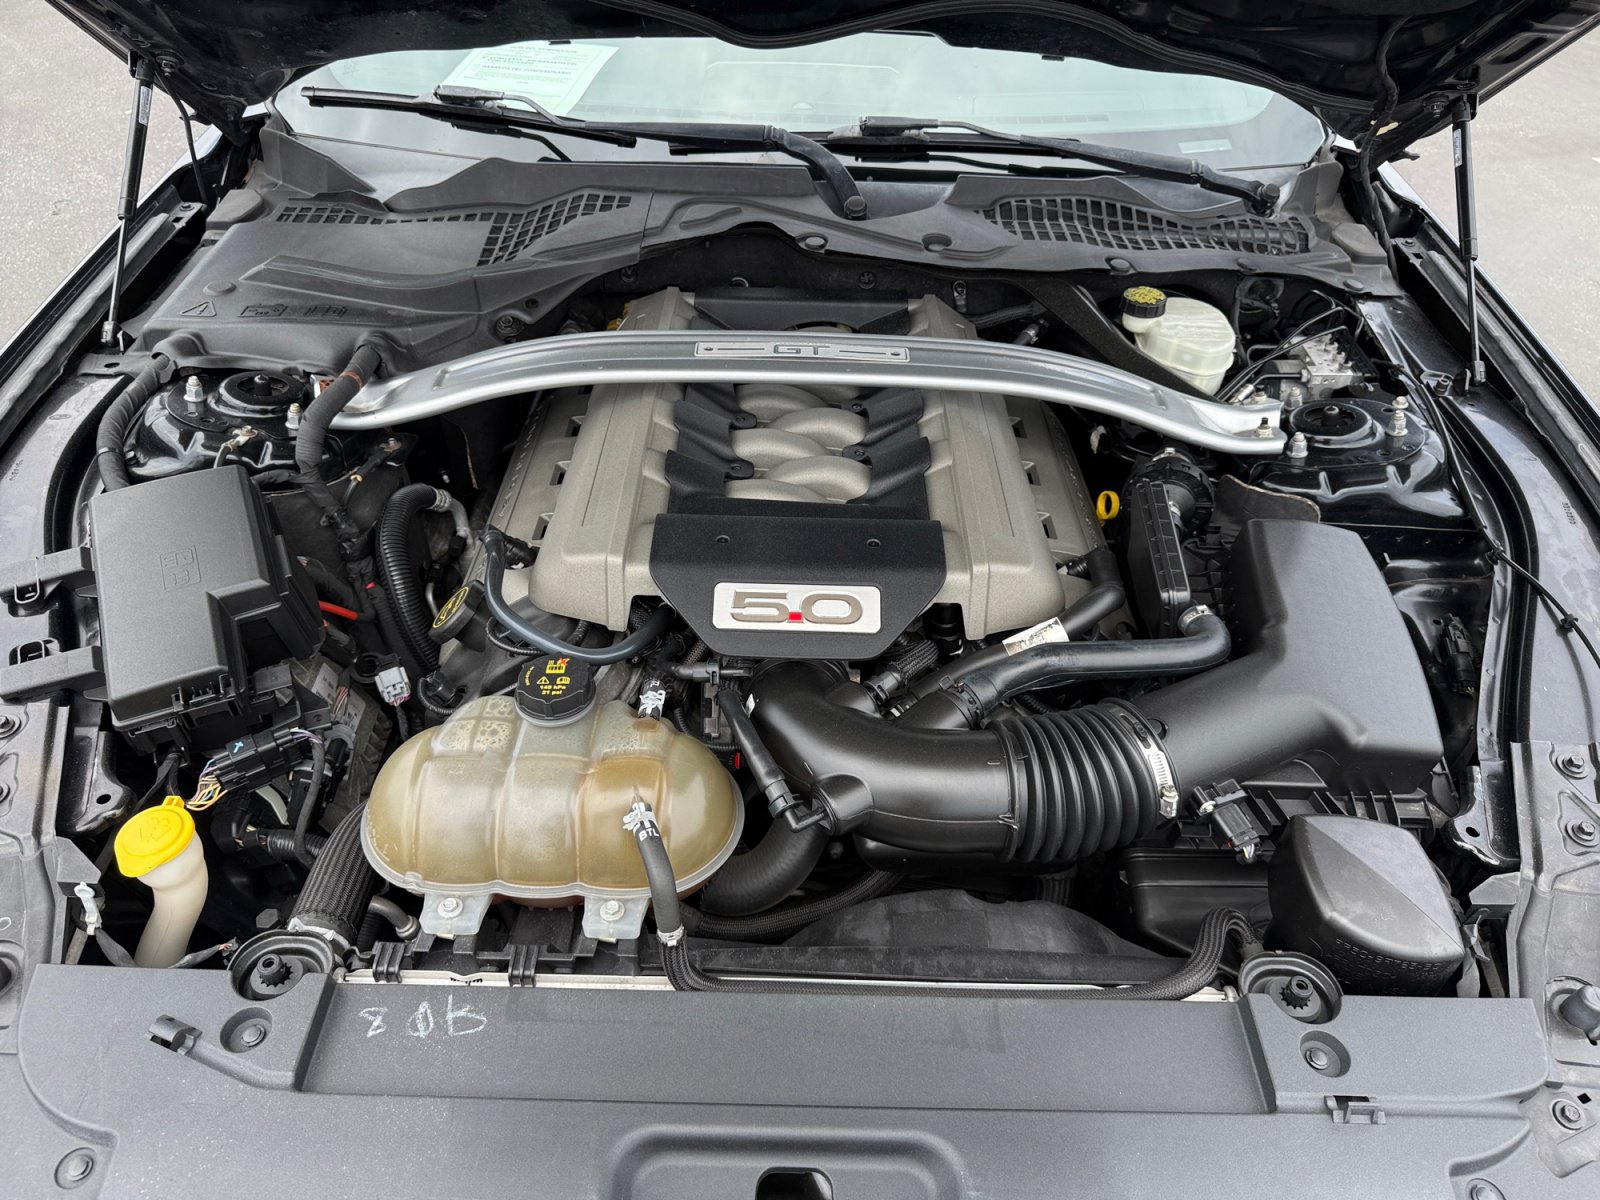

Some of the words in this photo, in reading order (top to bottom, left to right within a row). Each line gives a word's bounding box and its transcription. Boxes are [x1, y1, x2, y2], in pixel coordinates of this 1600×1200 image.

[773, 344, 830, 356] GT
[730, 590, 863, 625] 5.0
[638, 828, 660, 841] BTL
